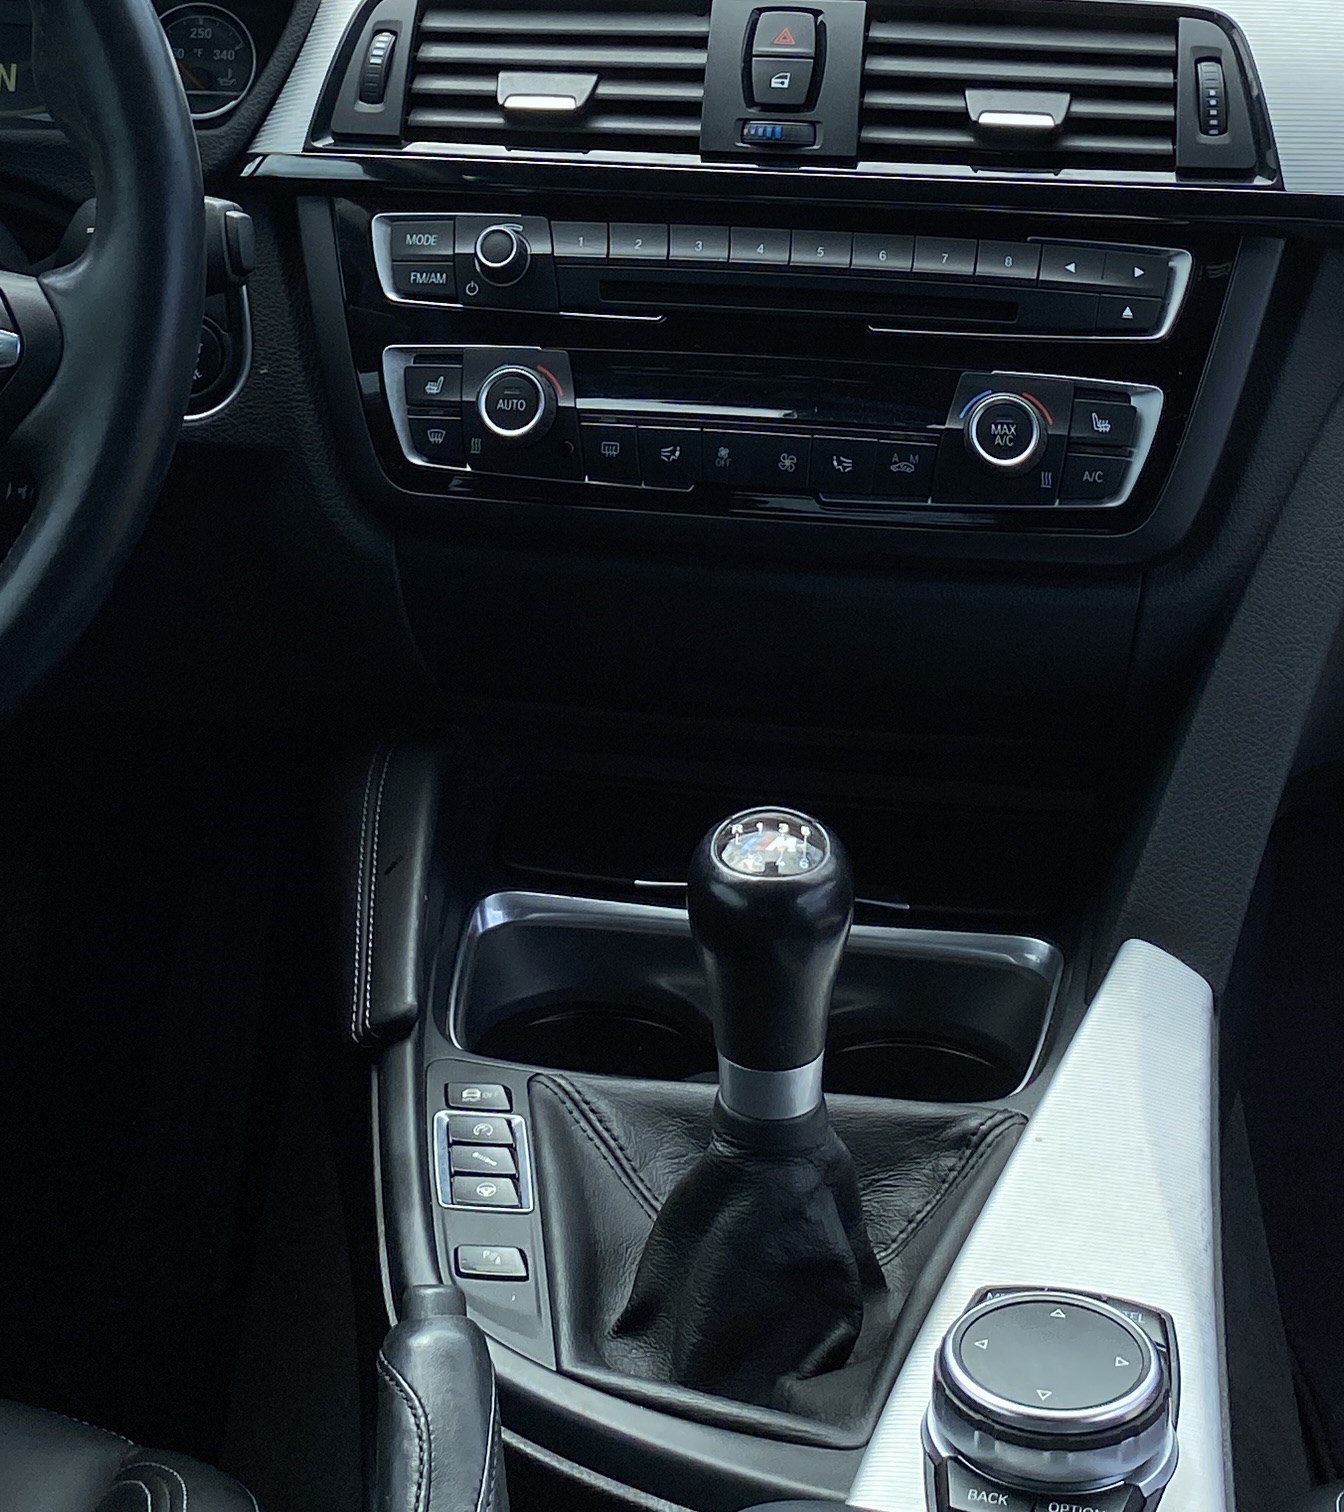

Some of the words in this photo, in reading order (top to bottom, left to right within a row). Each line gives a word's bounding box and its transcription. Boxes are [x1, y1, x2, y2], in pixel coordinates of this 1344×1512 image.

[190, 28, 212, 39] 250
[213, 49, 235, 60] 340
[405, 234, 438, 247] MODE
[577, 236, 584, 247] 1
[634, 238, 642, 250] 2
[694, 240, 703, 251] 3
[756, 243, 765, 254] 4
[816, 246, 825, 257] 5
[879, 250, 887, 261] 6
[941, 253, 949, 264] 7
[1004, 256, 1013, 268] 8
[410, 271, 446, 285] FM/AM
[496, 398, 526, 412] AUTO
[990, 422, 1017, 435] MAX
[994, 434, 1014, 447] A/C
[715, 457, 731, 467] OFF
[1082, 470, 1104, 484] A/C
[967, 1488, 1010, 1507] BACK
